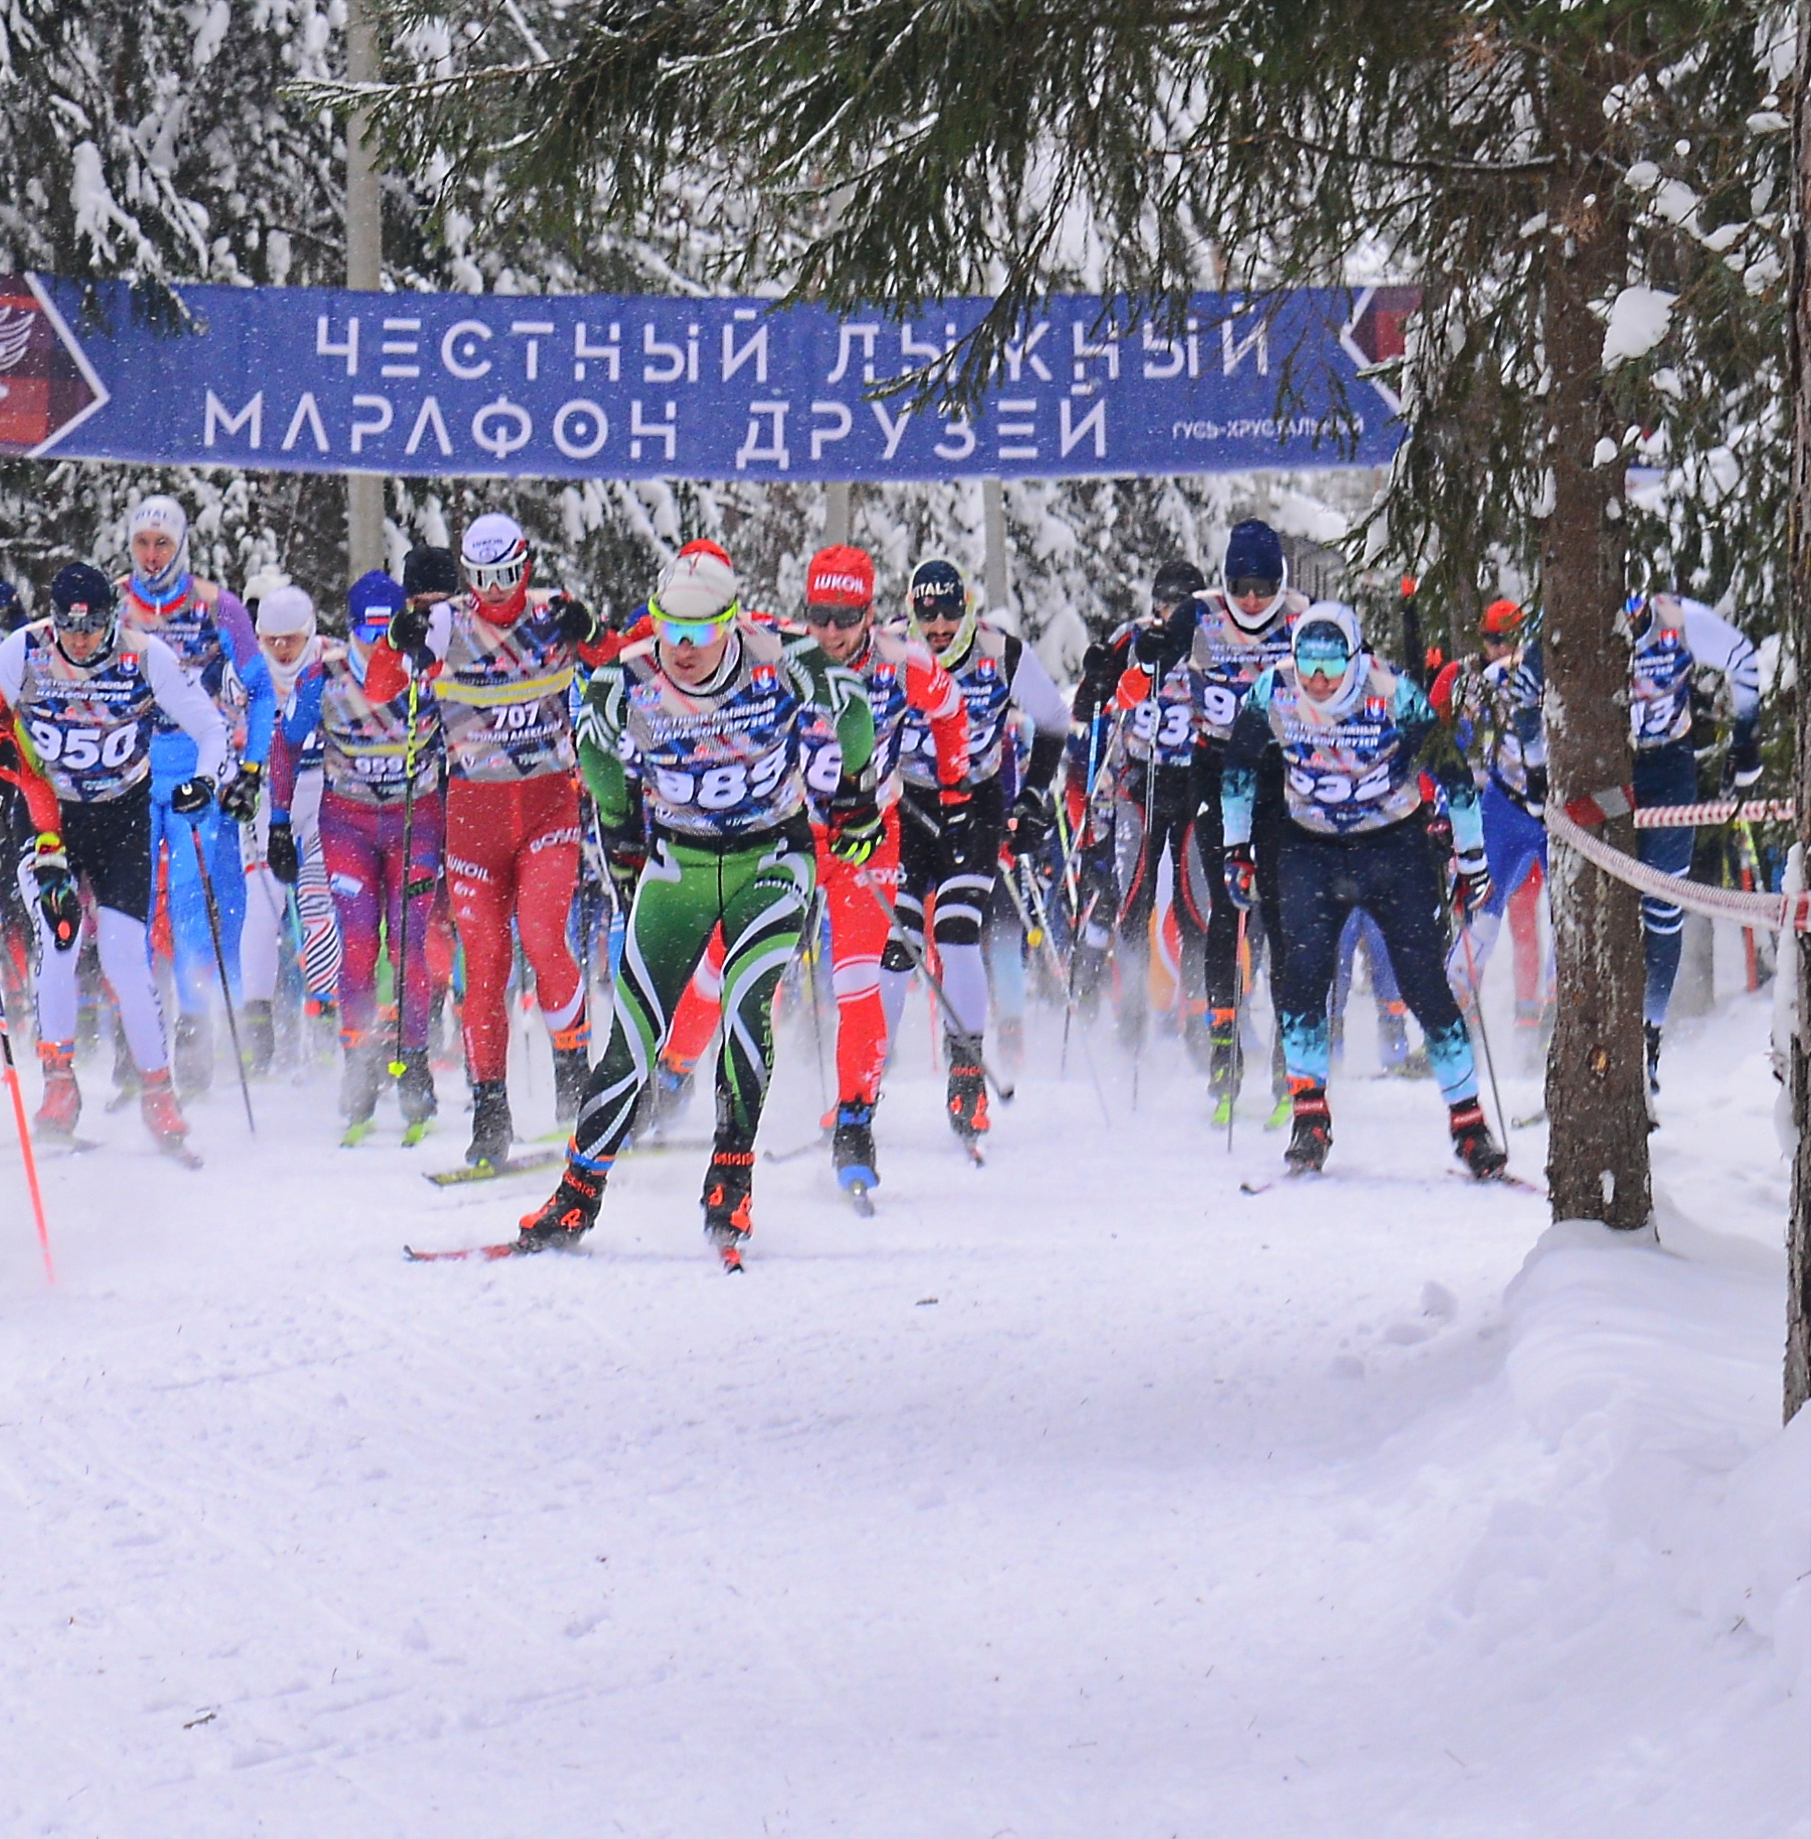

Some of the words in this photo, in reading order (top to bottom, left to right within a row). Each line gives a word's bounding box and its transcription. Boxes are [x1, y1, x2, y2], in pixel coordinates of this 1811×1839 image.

[316, 309, 768, 382] ЧЕСТНЫЙ
[827, 302, 1269, 384] ЛЫЖНЫЙ
[203, 389, 676, 459] МАРАФОН
[736, 383, 1107, 470] ДРУЗЕЙ
[814, 573, 865, 594] LUKOIL
[492, 702, 540, 730] 707
[30, 719, 139, 770] 950
[653, 737, 789, 810] 989
[1289, 762, 1391, 803] 932
